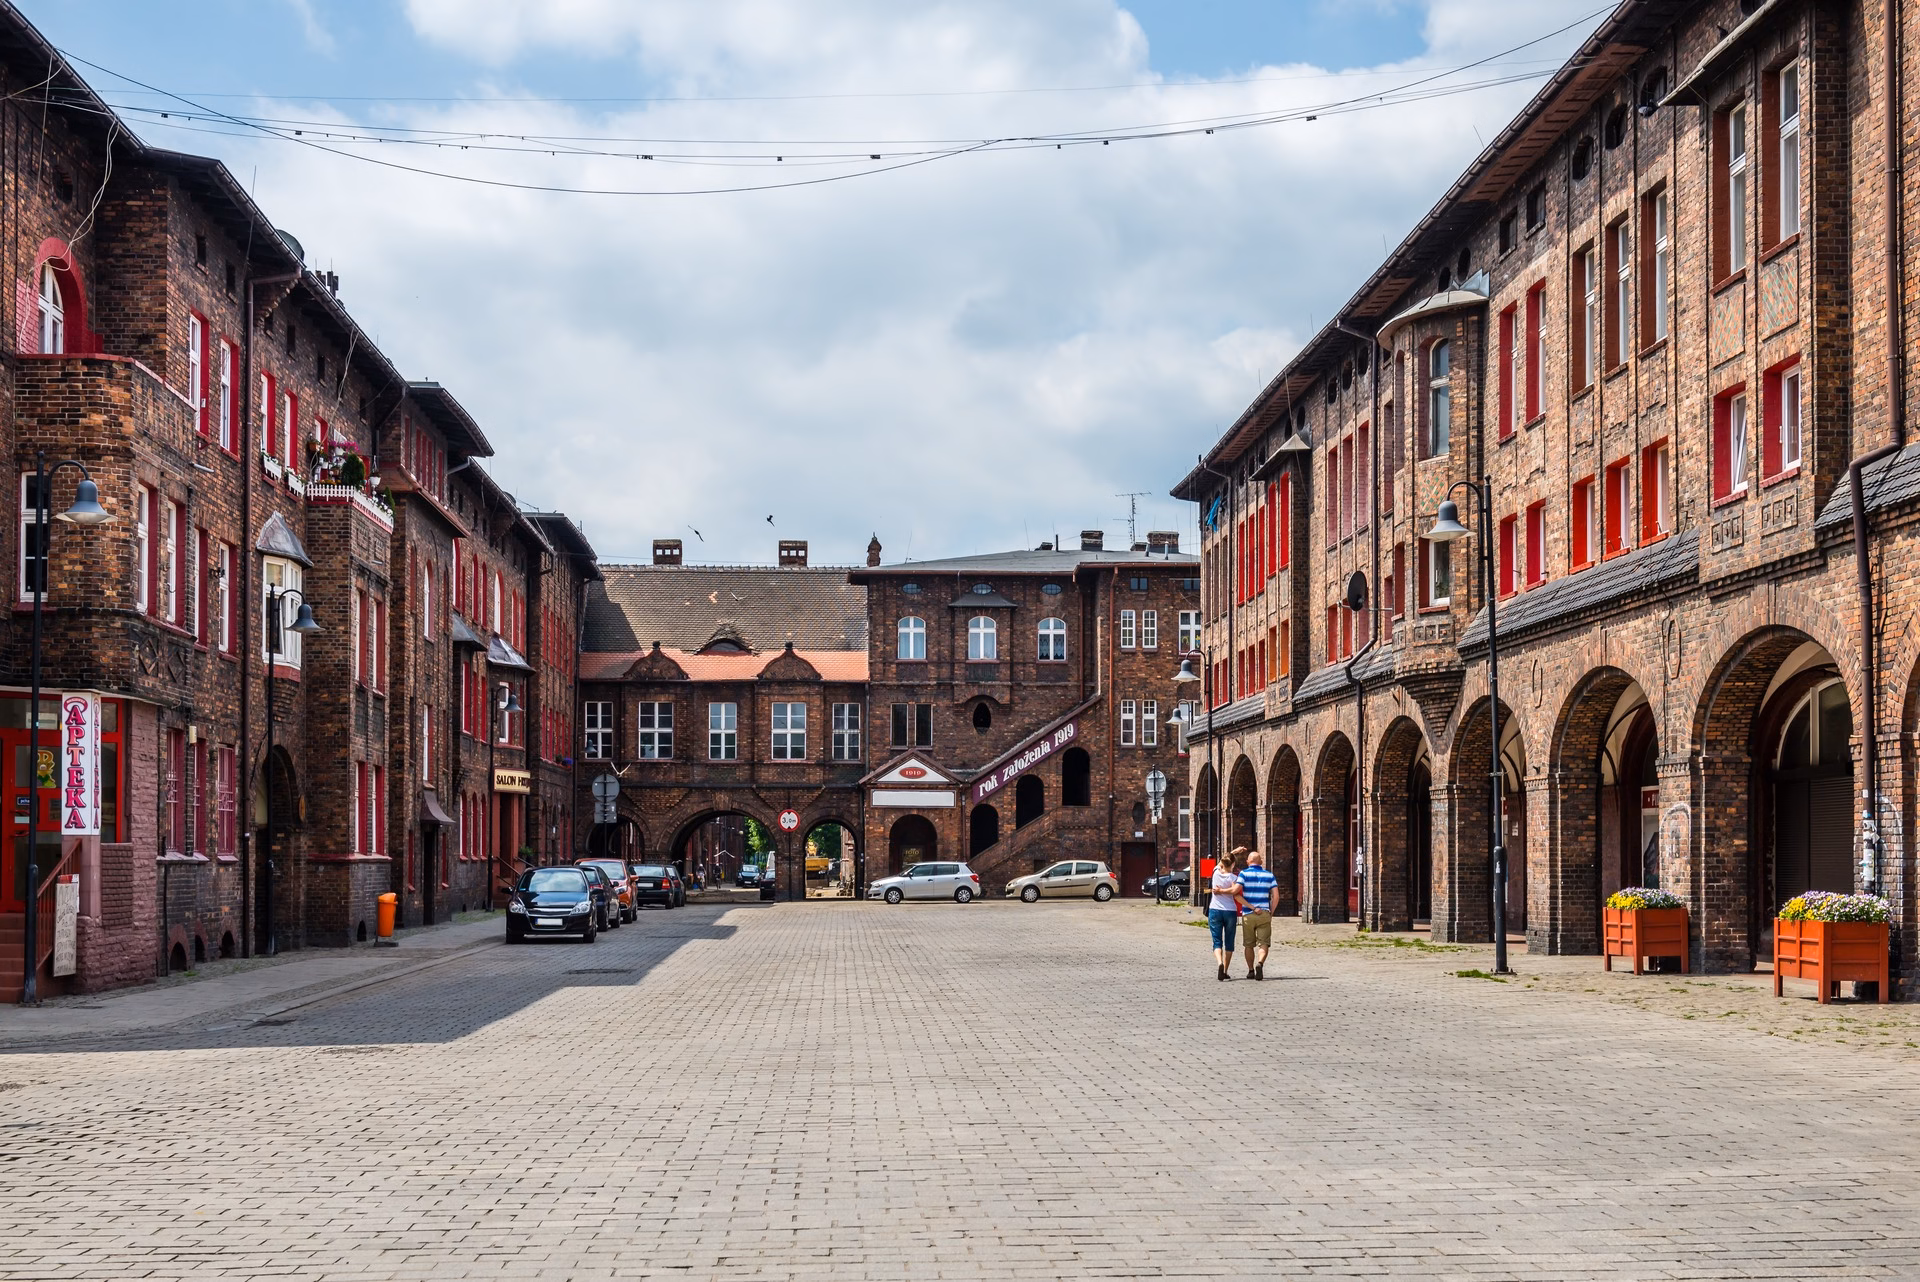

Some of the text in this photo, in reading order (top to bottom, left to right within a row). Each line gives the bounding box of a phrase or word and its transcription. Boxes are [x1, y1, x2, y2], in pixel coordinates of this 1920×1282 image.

[65, 704, 87, 828] APTEKA
[496, 774, 517, 786] SALON
[979, 723, 1074, 797] rok założenia 1919
